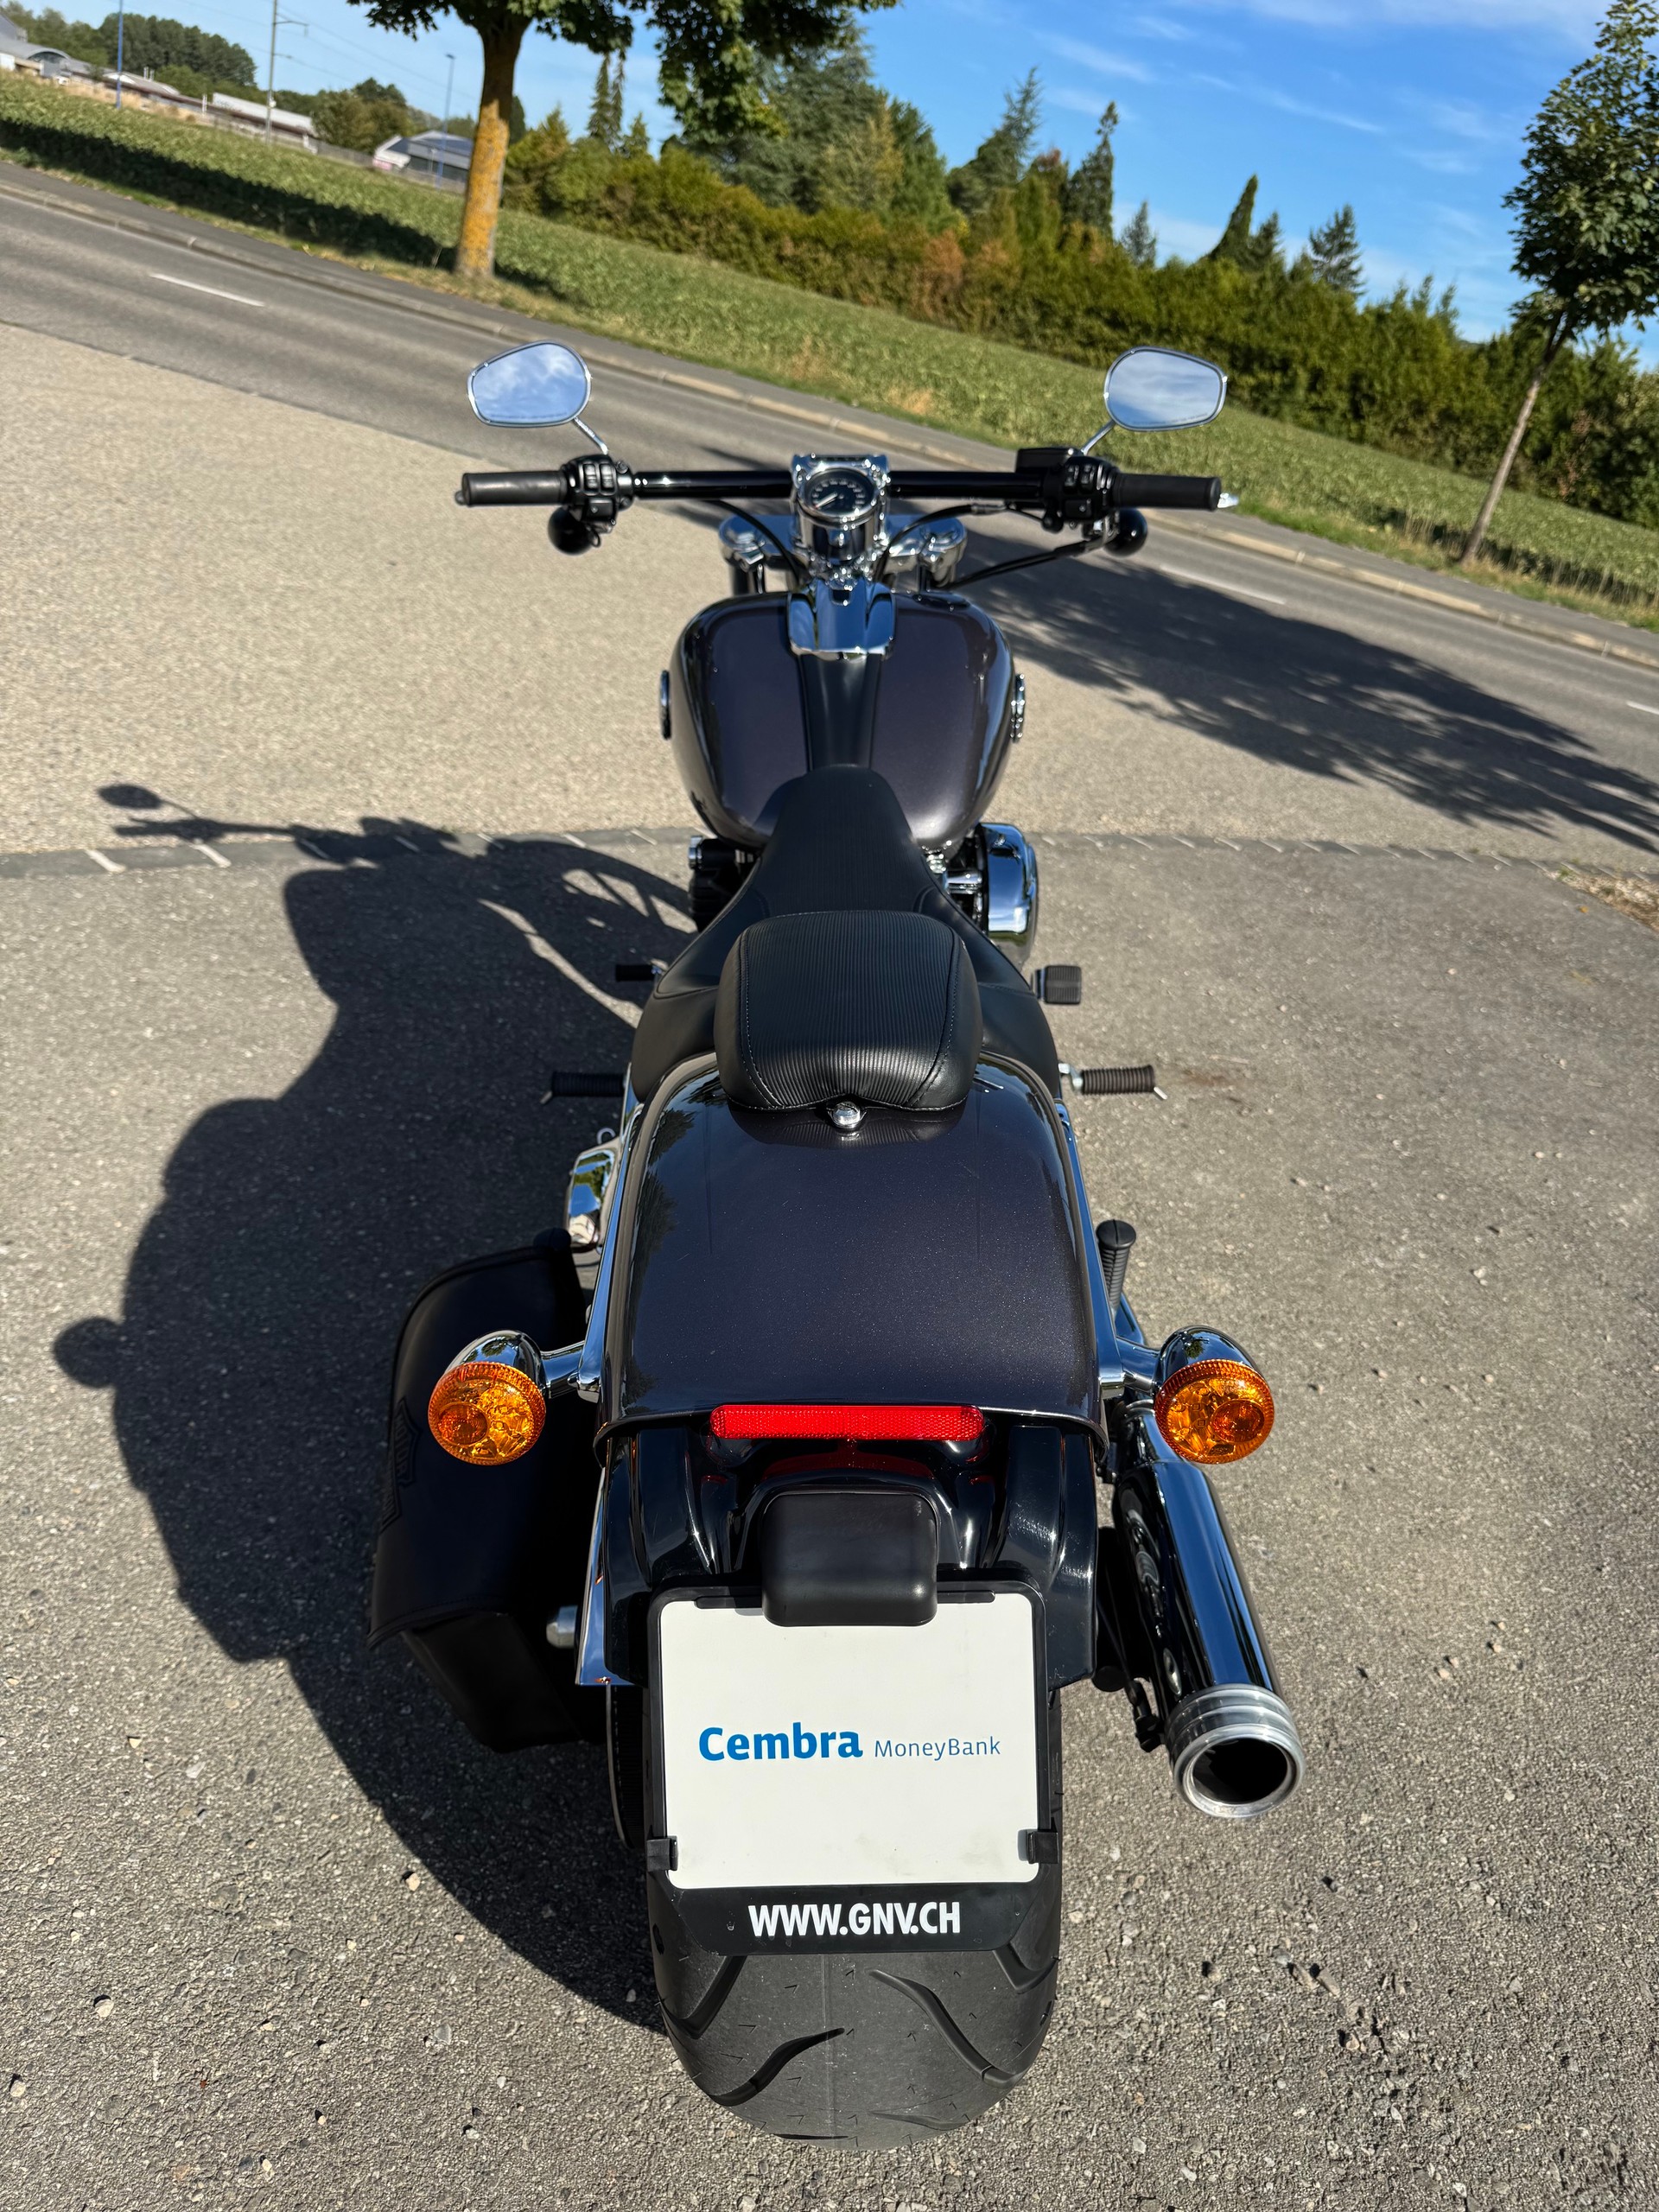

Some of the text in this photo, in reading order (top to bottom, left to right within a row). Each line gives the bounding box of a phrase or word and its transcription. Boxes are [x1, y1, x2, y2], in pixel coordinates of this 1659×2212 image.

[698, 1721, 1002, 1762] Cembra MoneyBank
[747, 1901, 961, 1937] WWW.GNV.CH
